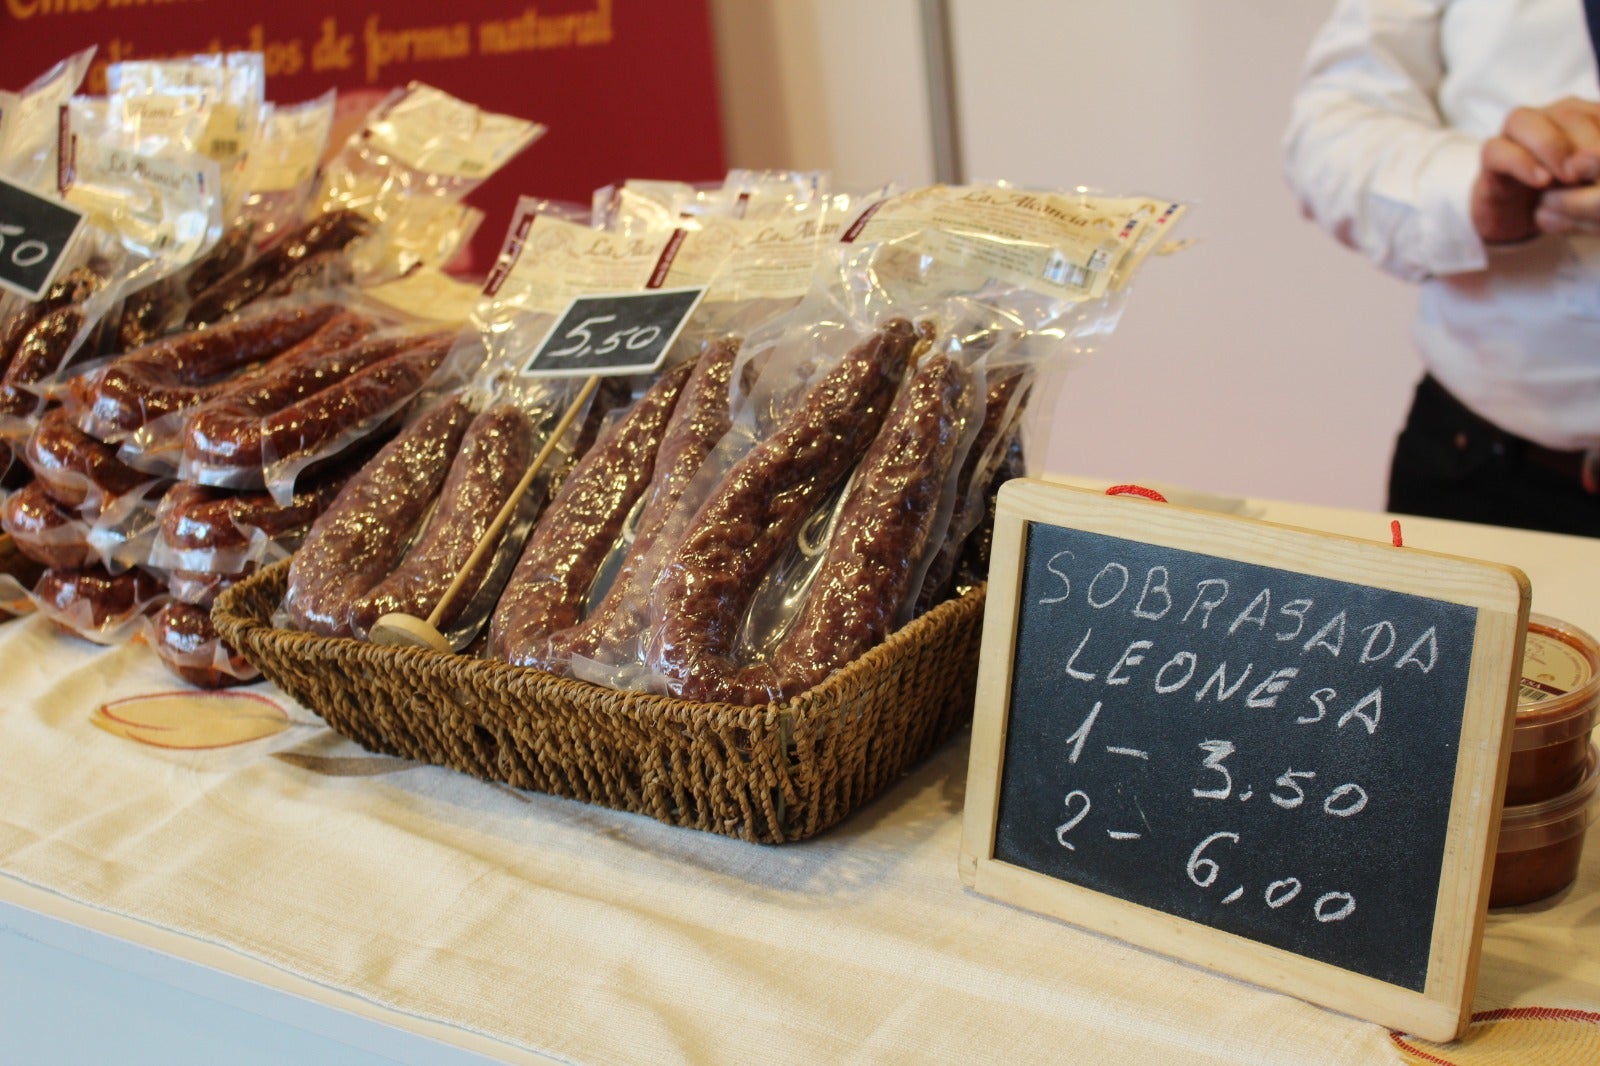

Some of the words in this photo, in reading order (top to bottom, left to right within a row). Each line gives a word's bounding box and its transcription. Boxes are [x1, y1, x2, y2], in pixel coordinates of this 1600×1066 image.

[547, 314, 661, 357] 5,50
[1039, 550, 1439, 674] SOBRASADA
[1065, 627, 1383, 735] LEONESA
[1186, 831, 1357, 923] 6,00
